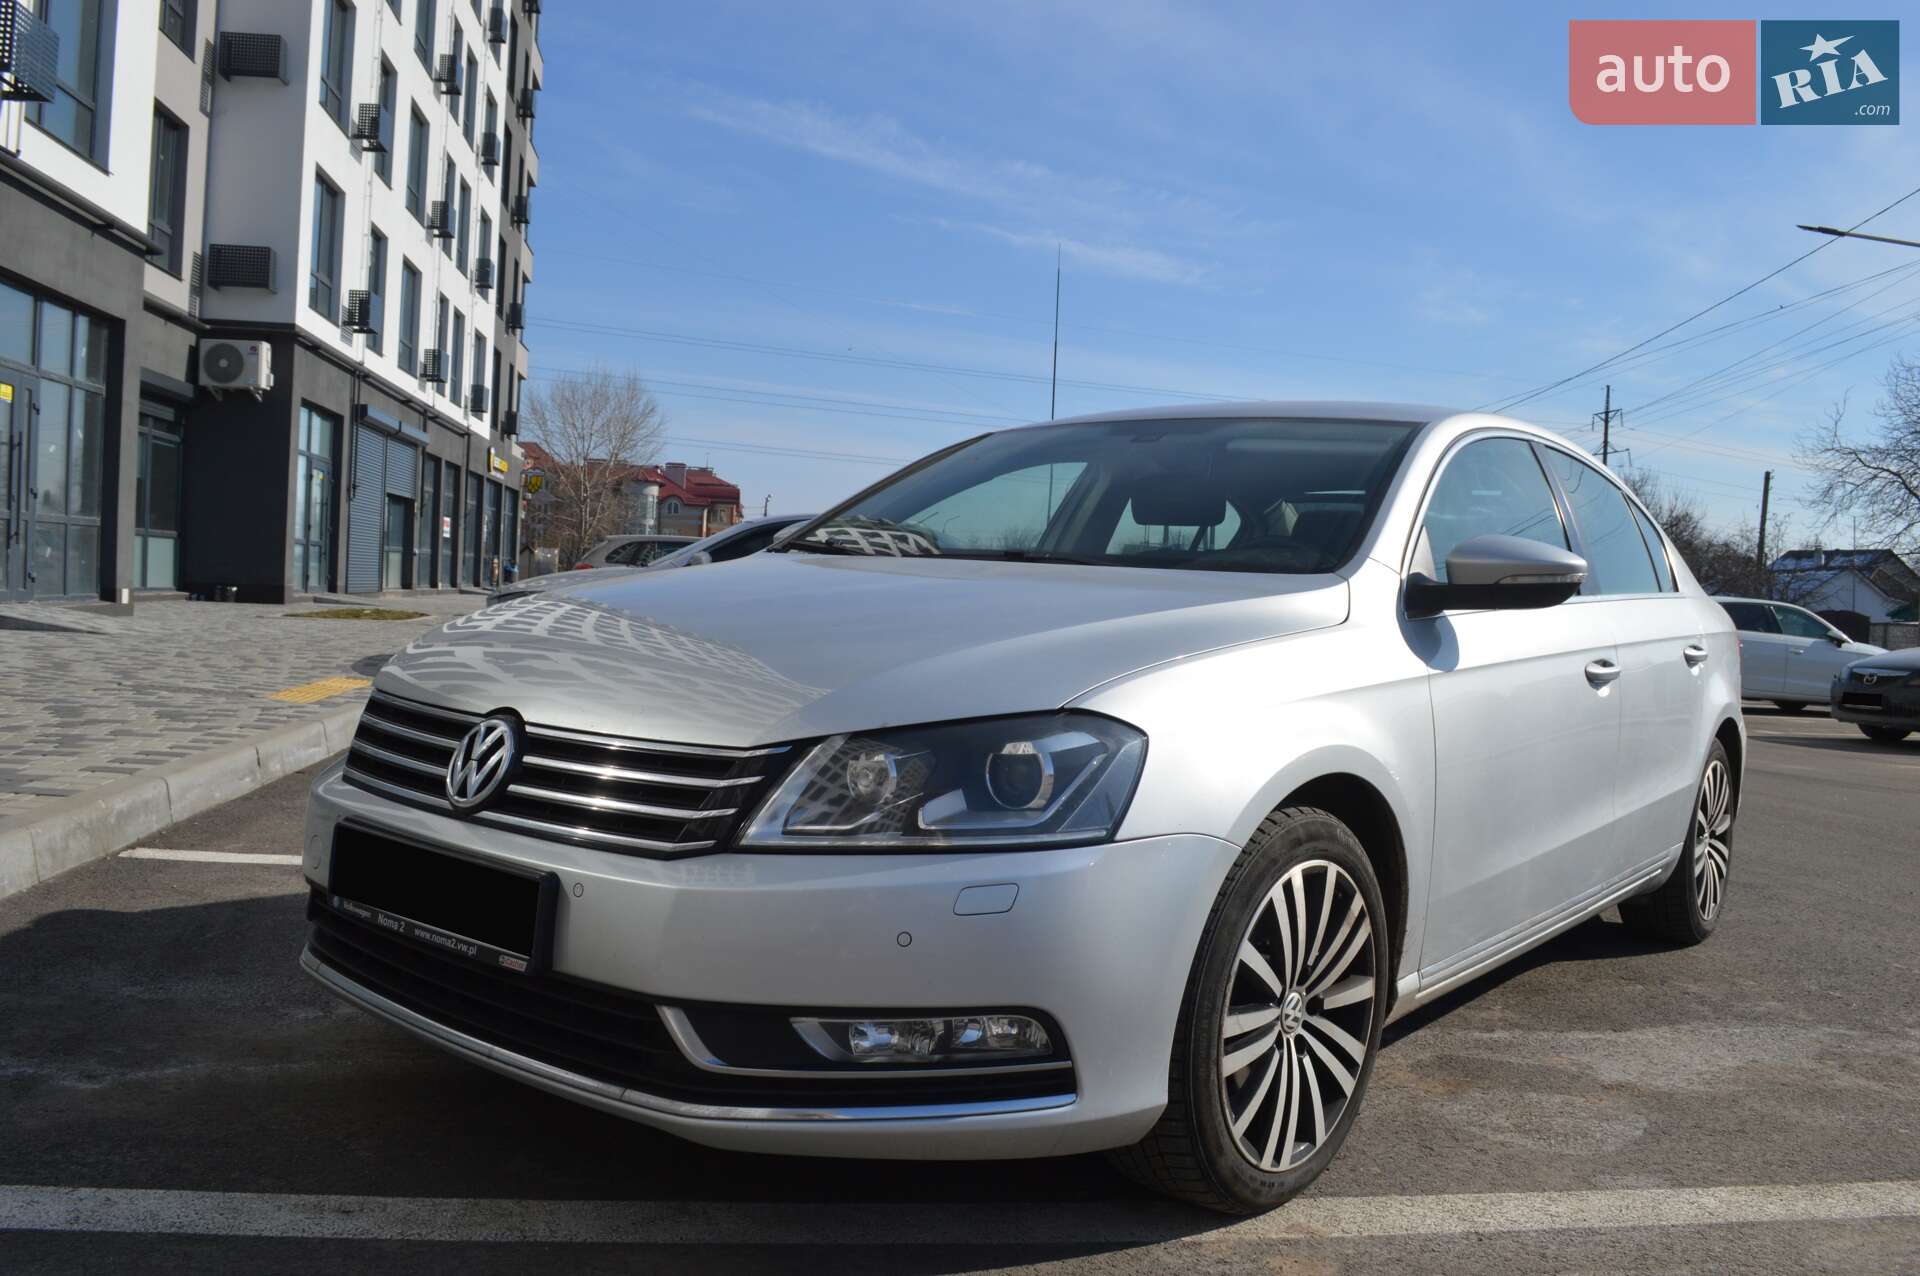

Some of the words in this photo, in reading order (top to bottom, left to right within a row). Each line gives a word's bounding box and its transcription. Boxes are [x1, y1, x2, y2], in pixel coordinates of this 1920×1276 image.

[377, 913, 399, 931] Noma
[400, 921, 406, 933] 2
[414, 927, 477, 956] www.noma2.vw.pl
